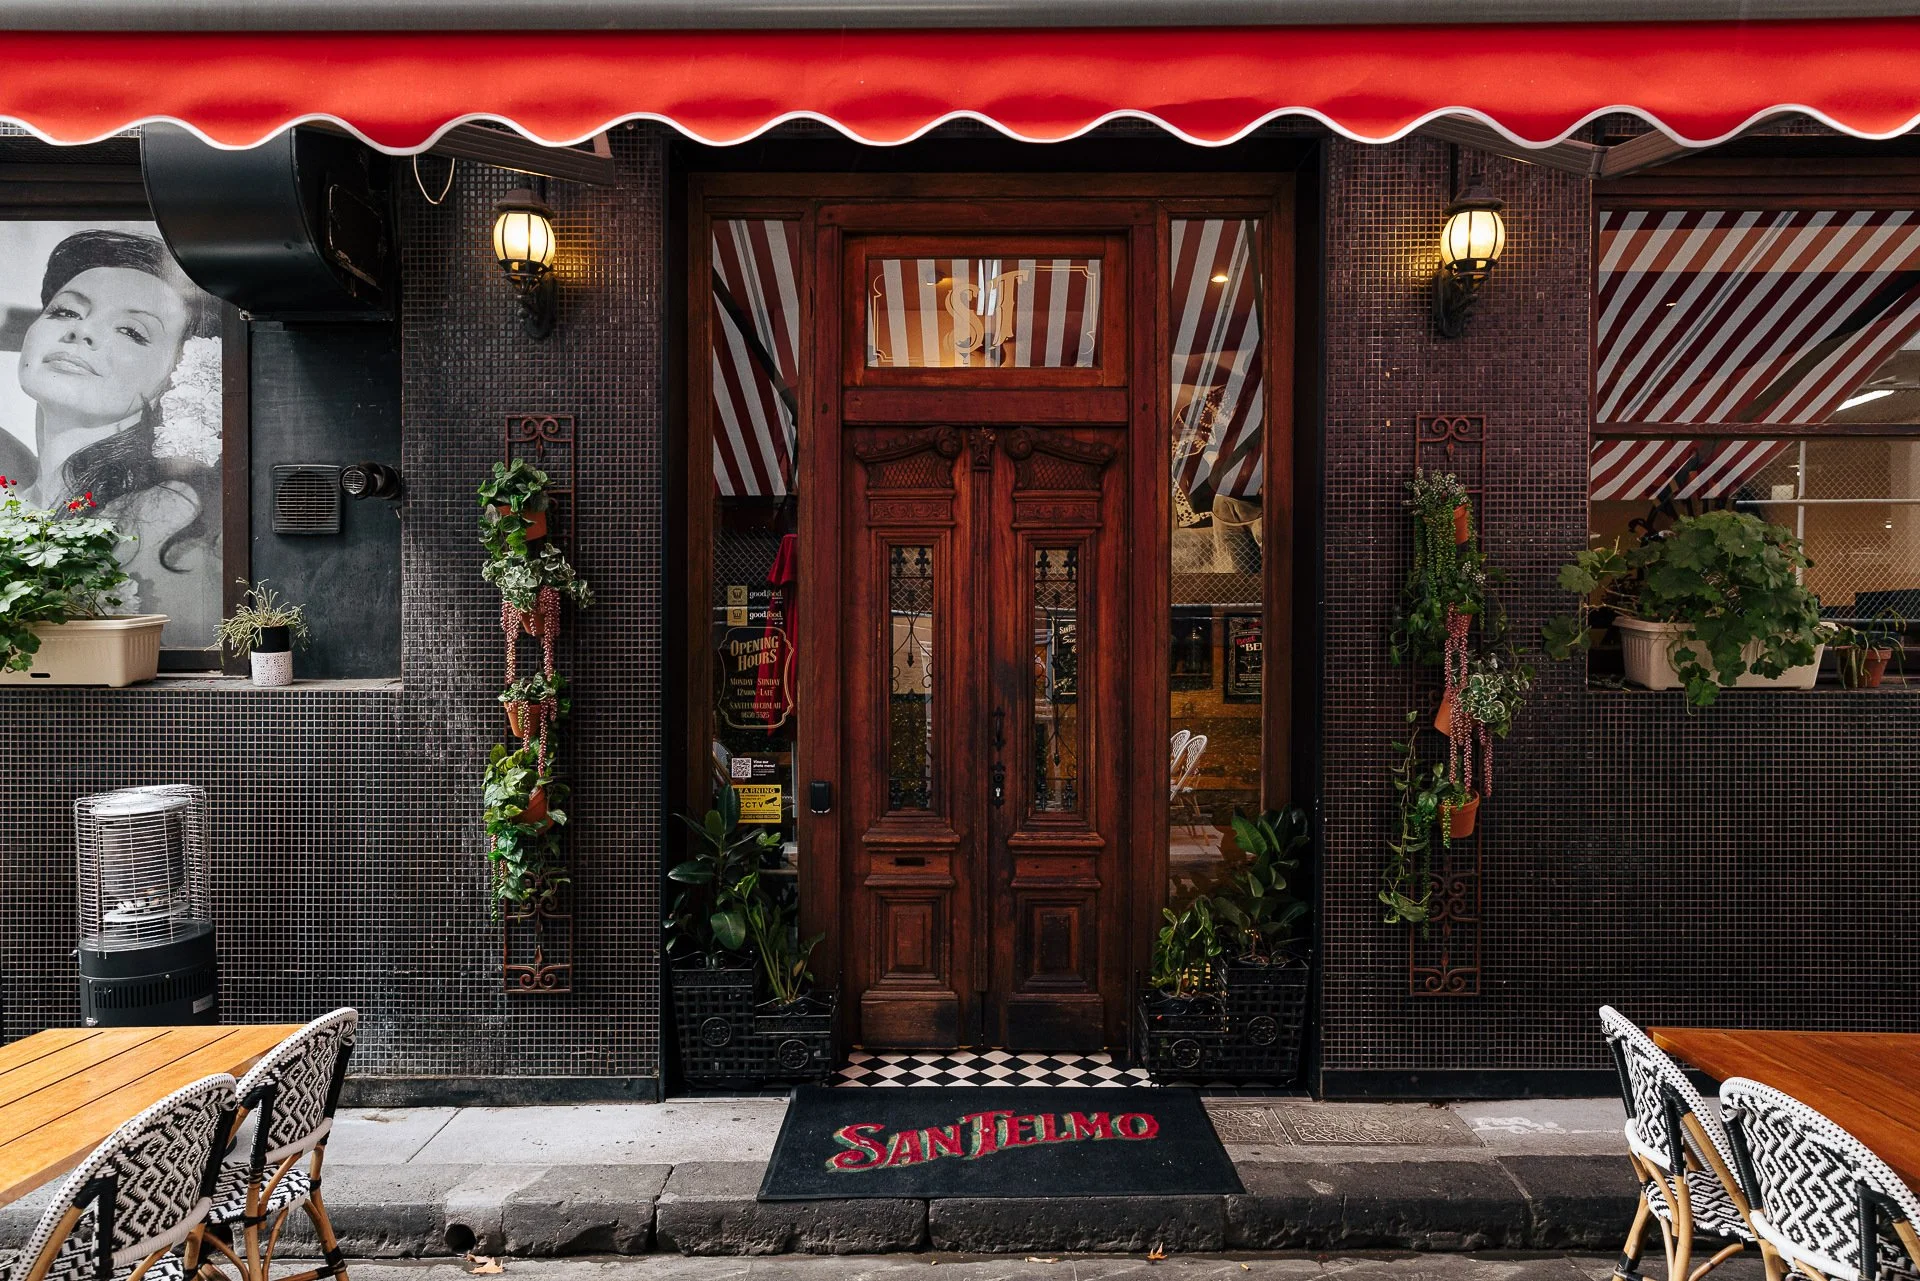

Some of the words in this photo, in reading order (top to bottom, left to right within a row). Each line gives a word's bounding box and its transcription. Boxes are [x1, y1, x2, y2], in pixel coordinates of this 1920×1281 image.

[730, 635, 779, 657] OPENING
[737, 648, 777, 672] HOURS
[730, 678, 753, 686] MONDAY
[757, 678, 781, 686] SUNDAY
[760, 688, 774, 696] LATE
